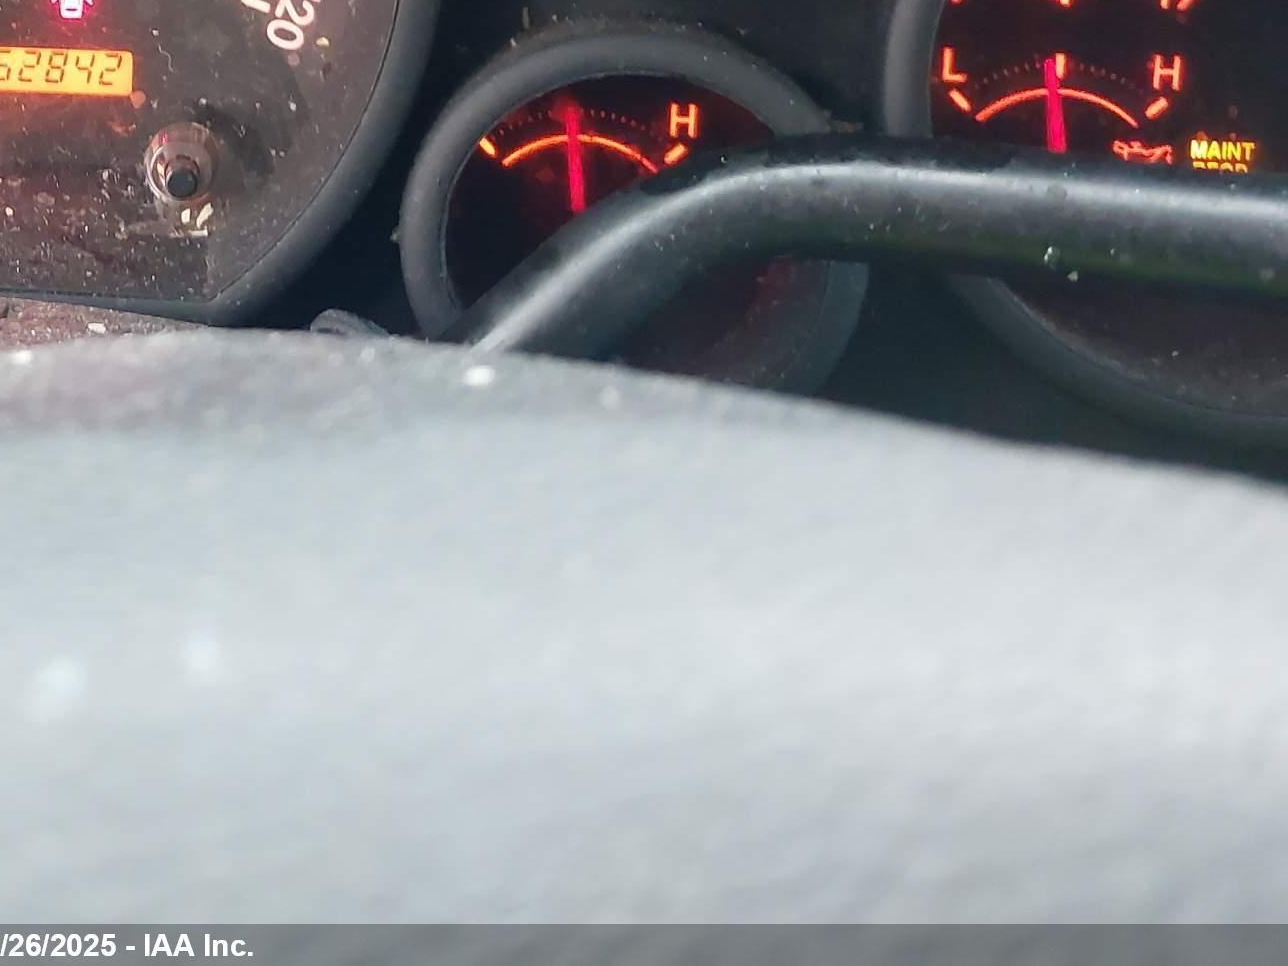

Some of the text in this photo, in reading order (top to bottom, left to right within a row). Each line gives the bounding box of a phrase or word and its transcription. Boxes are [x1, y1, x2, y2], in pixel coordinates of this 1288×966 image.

[941, 47, 968, 82] L
[1152, 54, 1182, 91] H
[669, 102, 699, 138] H
[1190, 139, 1256, 161] MAINT
